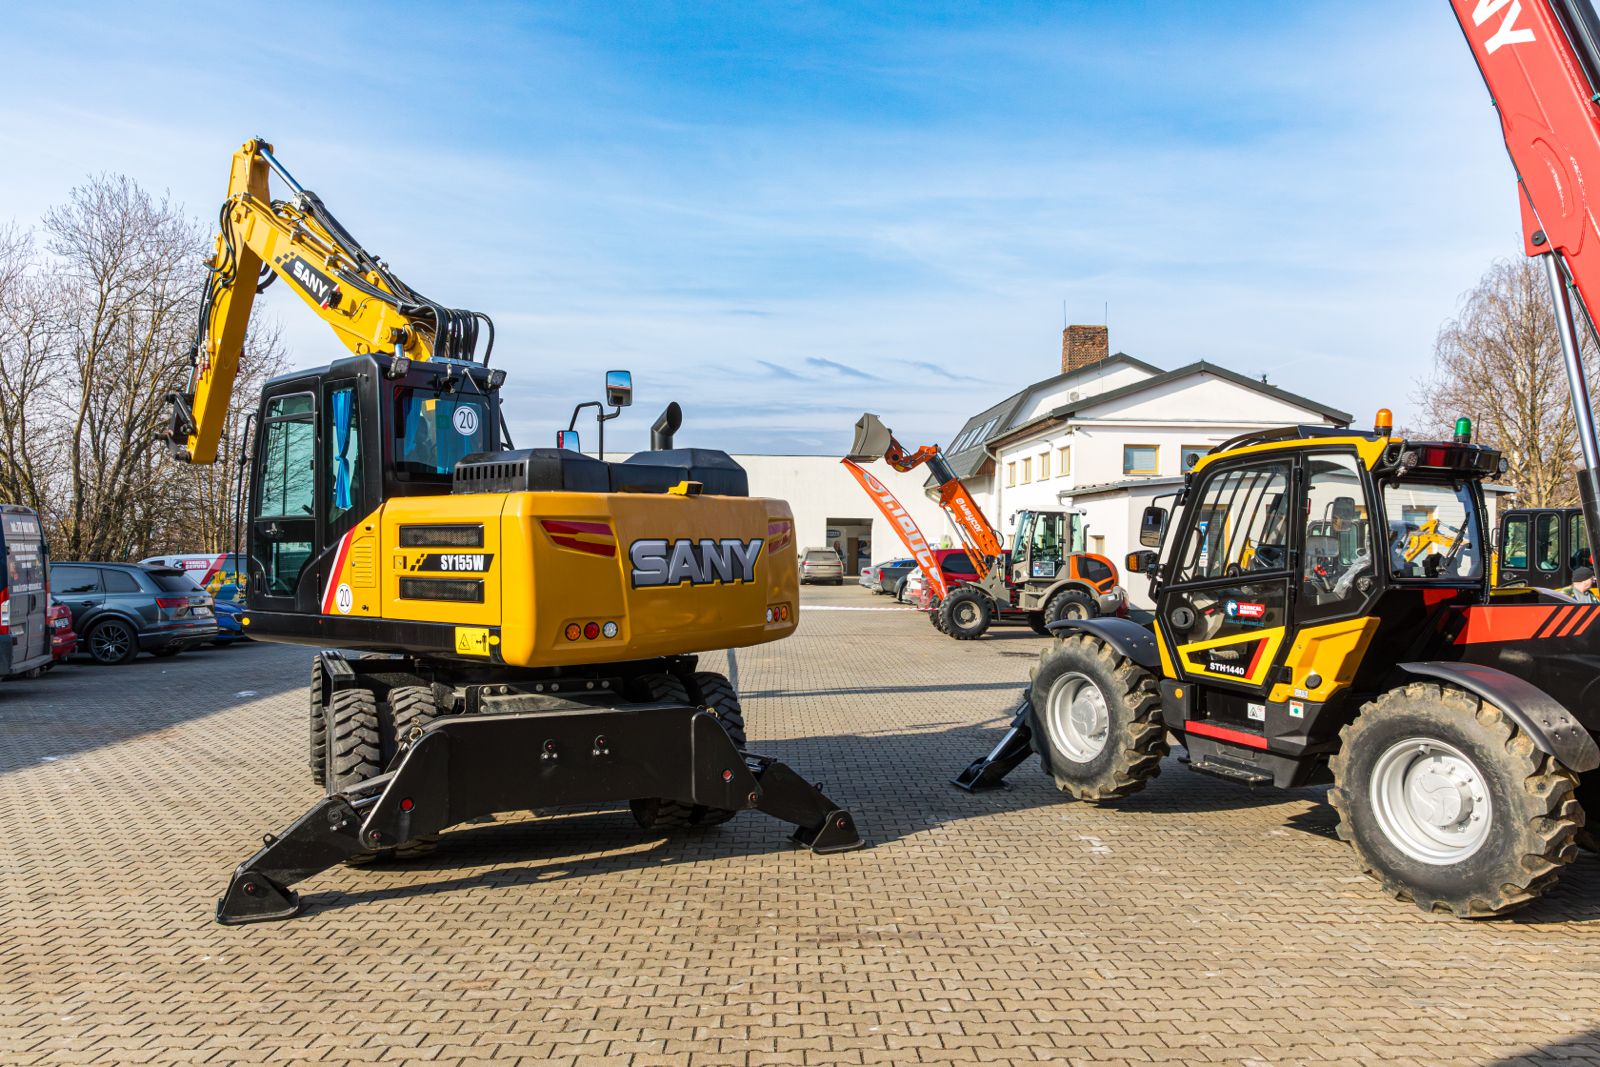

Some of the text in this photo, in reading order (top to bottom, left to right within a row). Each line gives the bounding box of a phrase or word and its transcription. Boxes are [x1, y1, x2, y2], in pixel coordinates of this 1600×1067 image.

[292, 261, 328, 298] SANY
[459, 411, 474, 428] 20
[440, 554, 484, 571] SY155W
[629, 538, 765, 589] SANY
[340, 588, 350, 607] 20
[1209, 662, 1245, 675] STH1440
